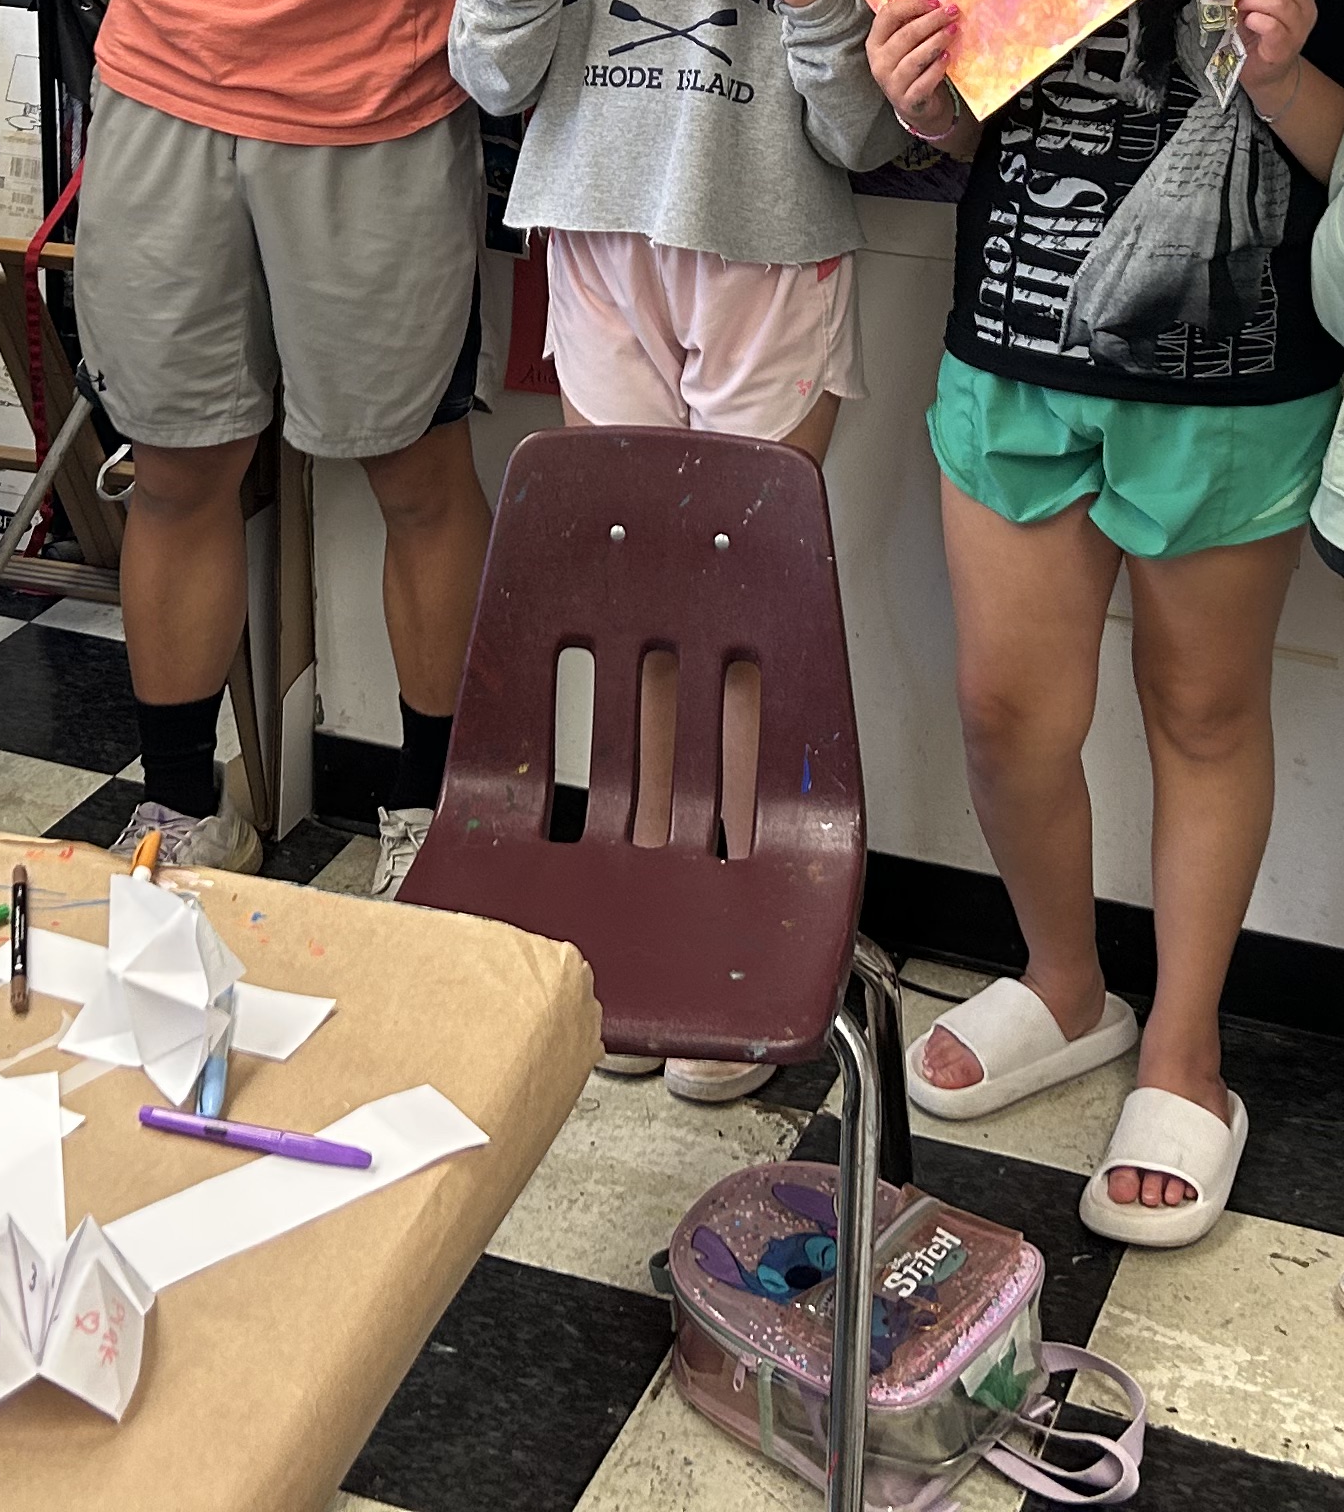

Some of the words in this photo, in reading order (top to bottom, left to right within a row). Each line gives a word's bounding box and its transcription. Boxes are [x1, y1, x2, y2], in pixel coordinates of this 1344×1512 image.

[582, 65, 662, 89] RHODE
[973, 199, 1021, 345] TOUR
[1007, 177, 1109, 366] SWIFT
